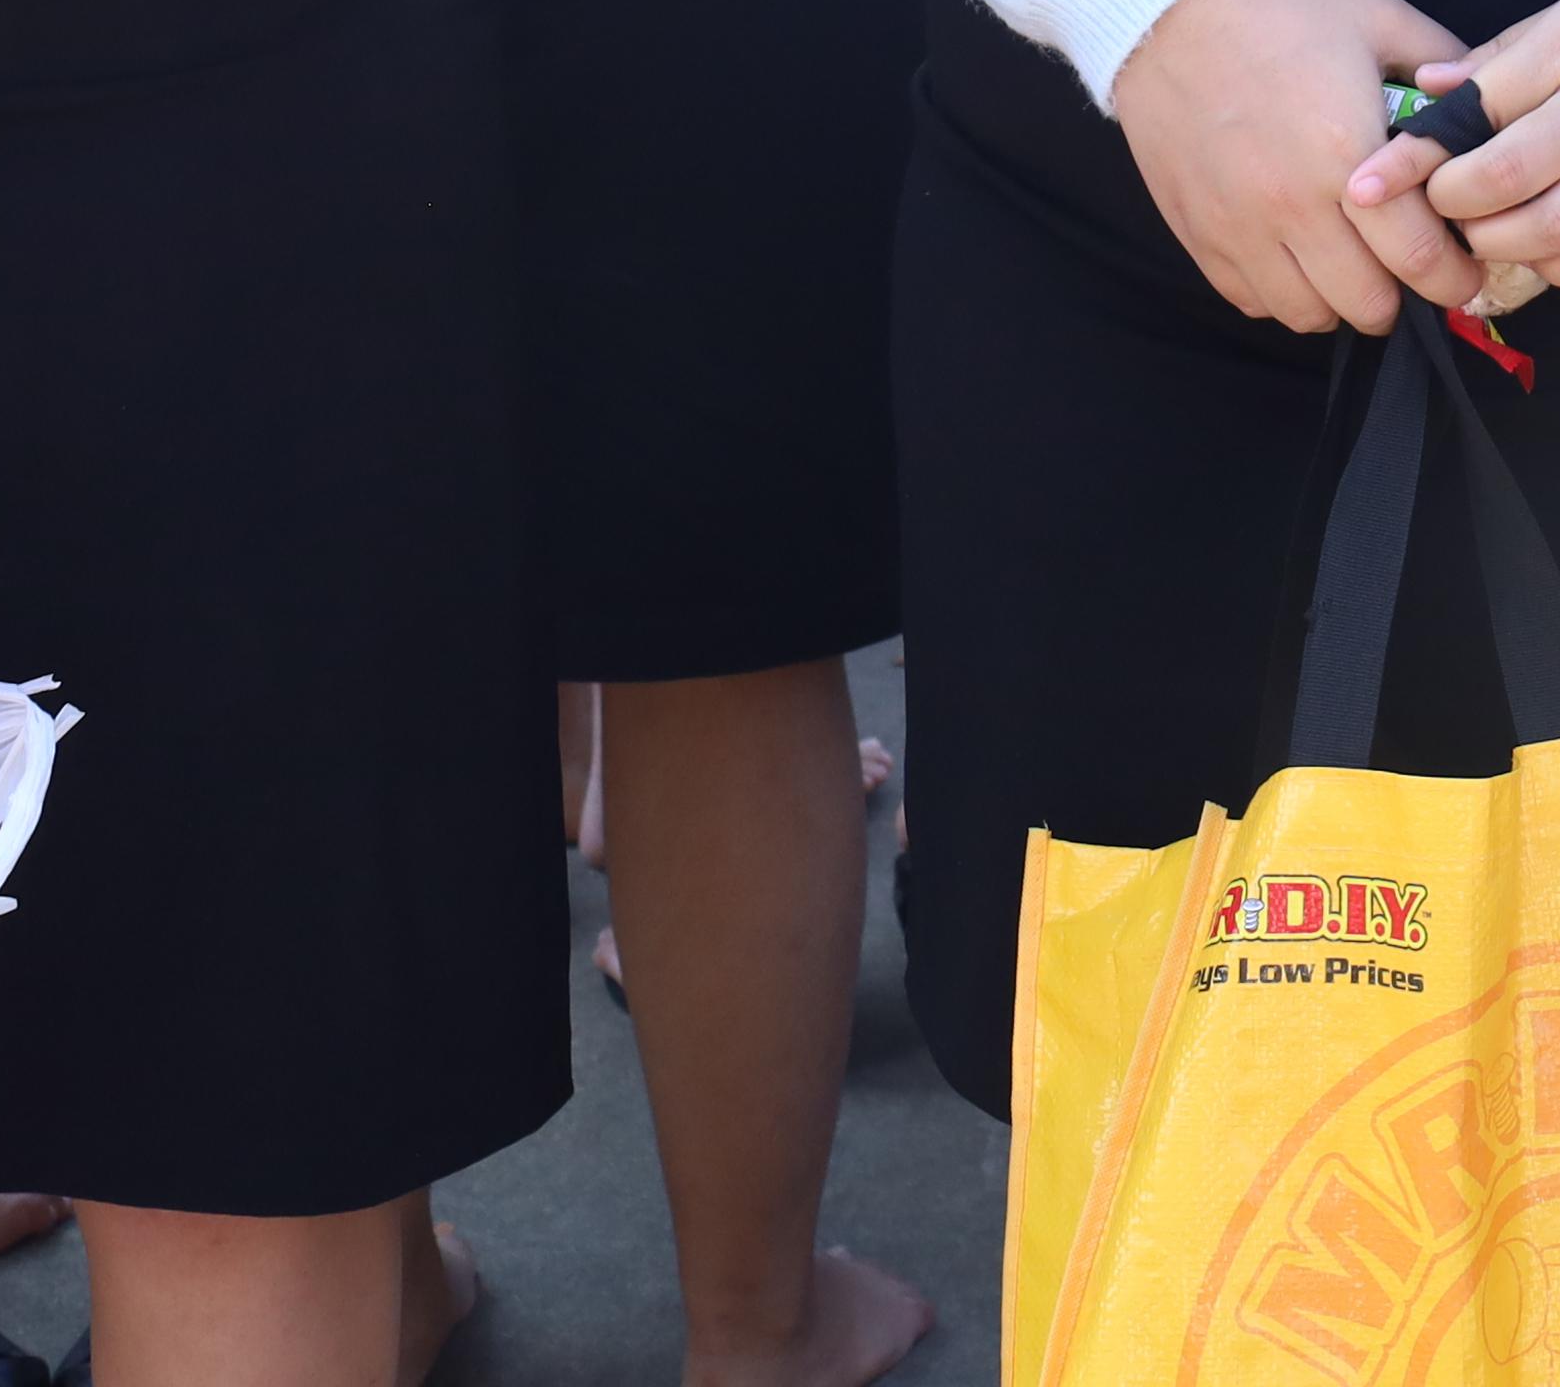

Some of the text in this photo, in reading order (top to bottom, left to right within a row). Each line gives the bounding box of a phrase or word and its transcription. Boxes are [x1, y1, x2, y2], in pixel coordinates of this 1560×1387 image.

[1206, 875, 1427, 951] R.D.I.Y.
[1191, 957, 1425, 993] ays Low Prices
